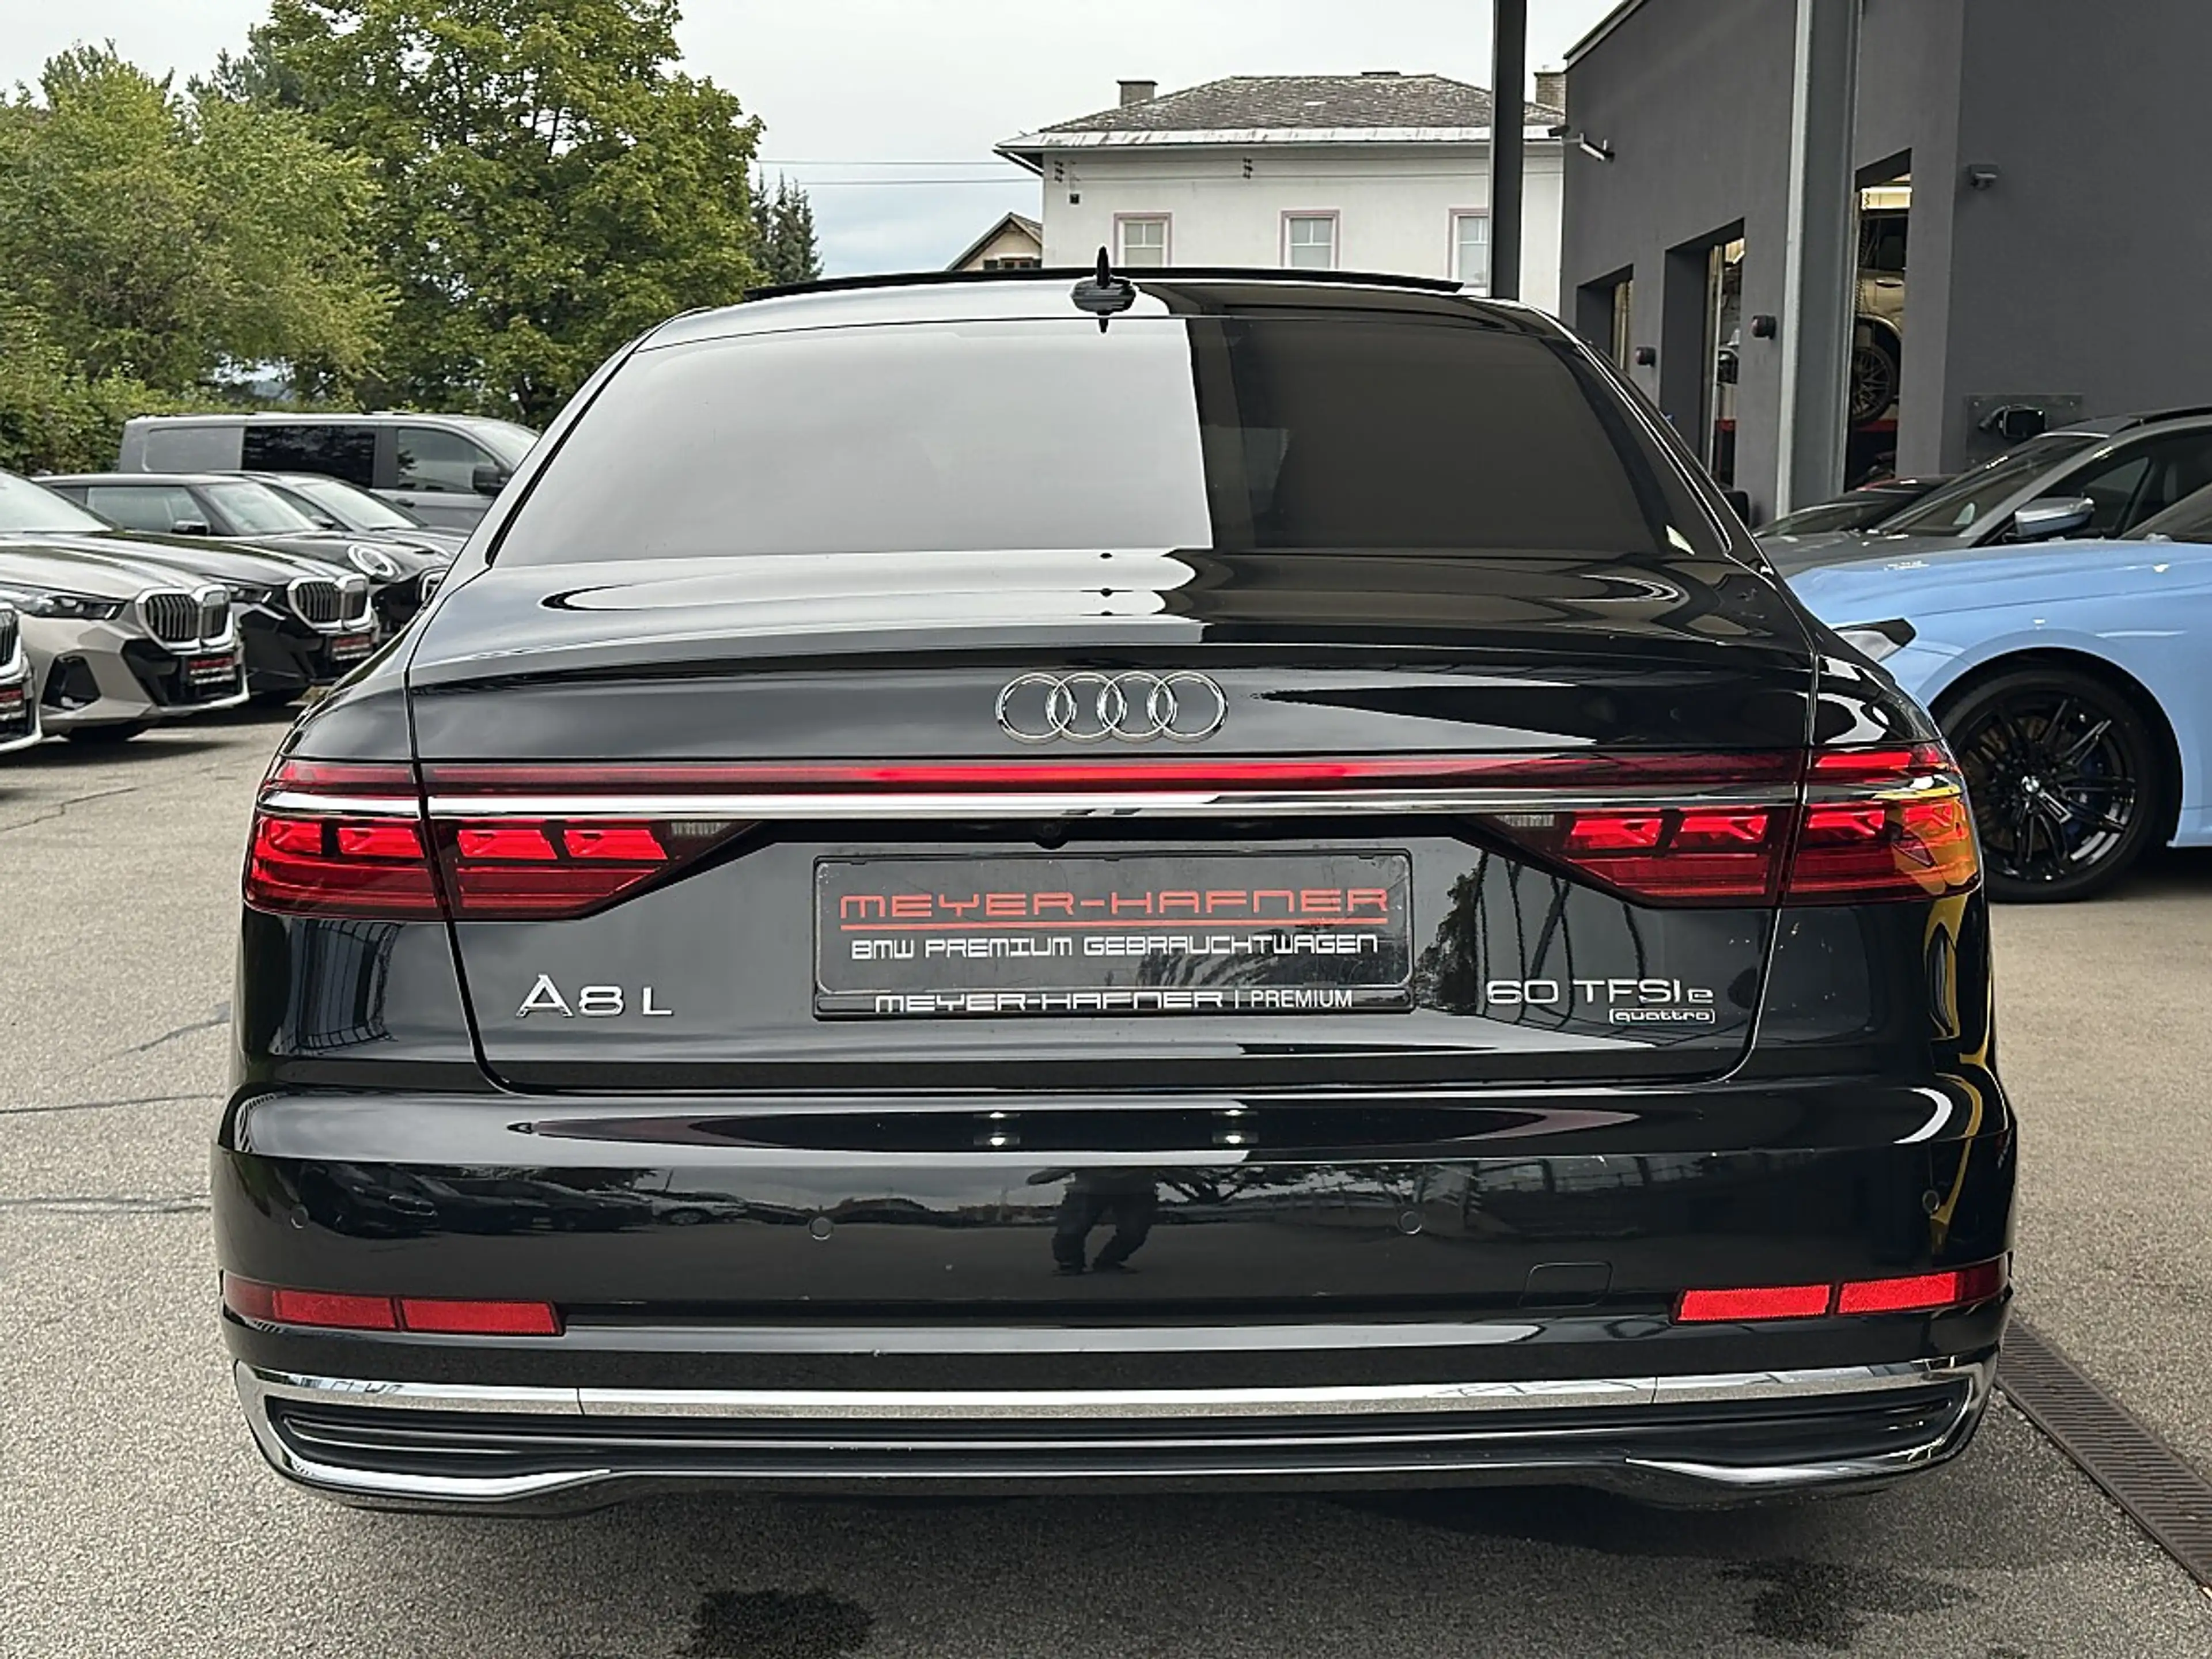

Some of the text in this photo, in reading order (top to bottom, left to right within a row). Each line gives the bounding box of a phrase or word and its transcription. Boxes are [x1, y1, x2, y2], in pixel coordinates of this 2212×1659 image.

[840, 889, 1388, 918] MEYER-HAFNER
[851, 934, 1378, 960] BMW PREMIUM GEBRAUCHTWAGEN
[875, 991, 1222, 1013] MEYER-HAFNER
[1251, 990, 1353, 1008] PREMIUM
[1486, 980, 1559, 1004] 60
[1614, 1012, 1711, 1022] quattro
